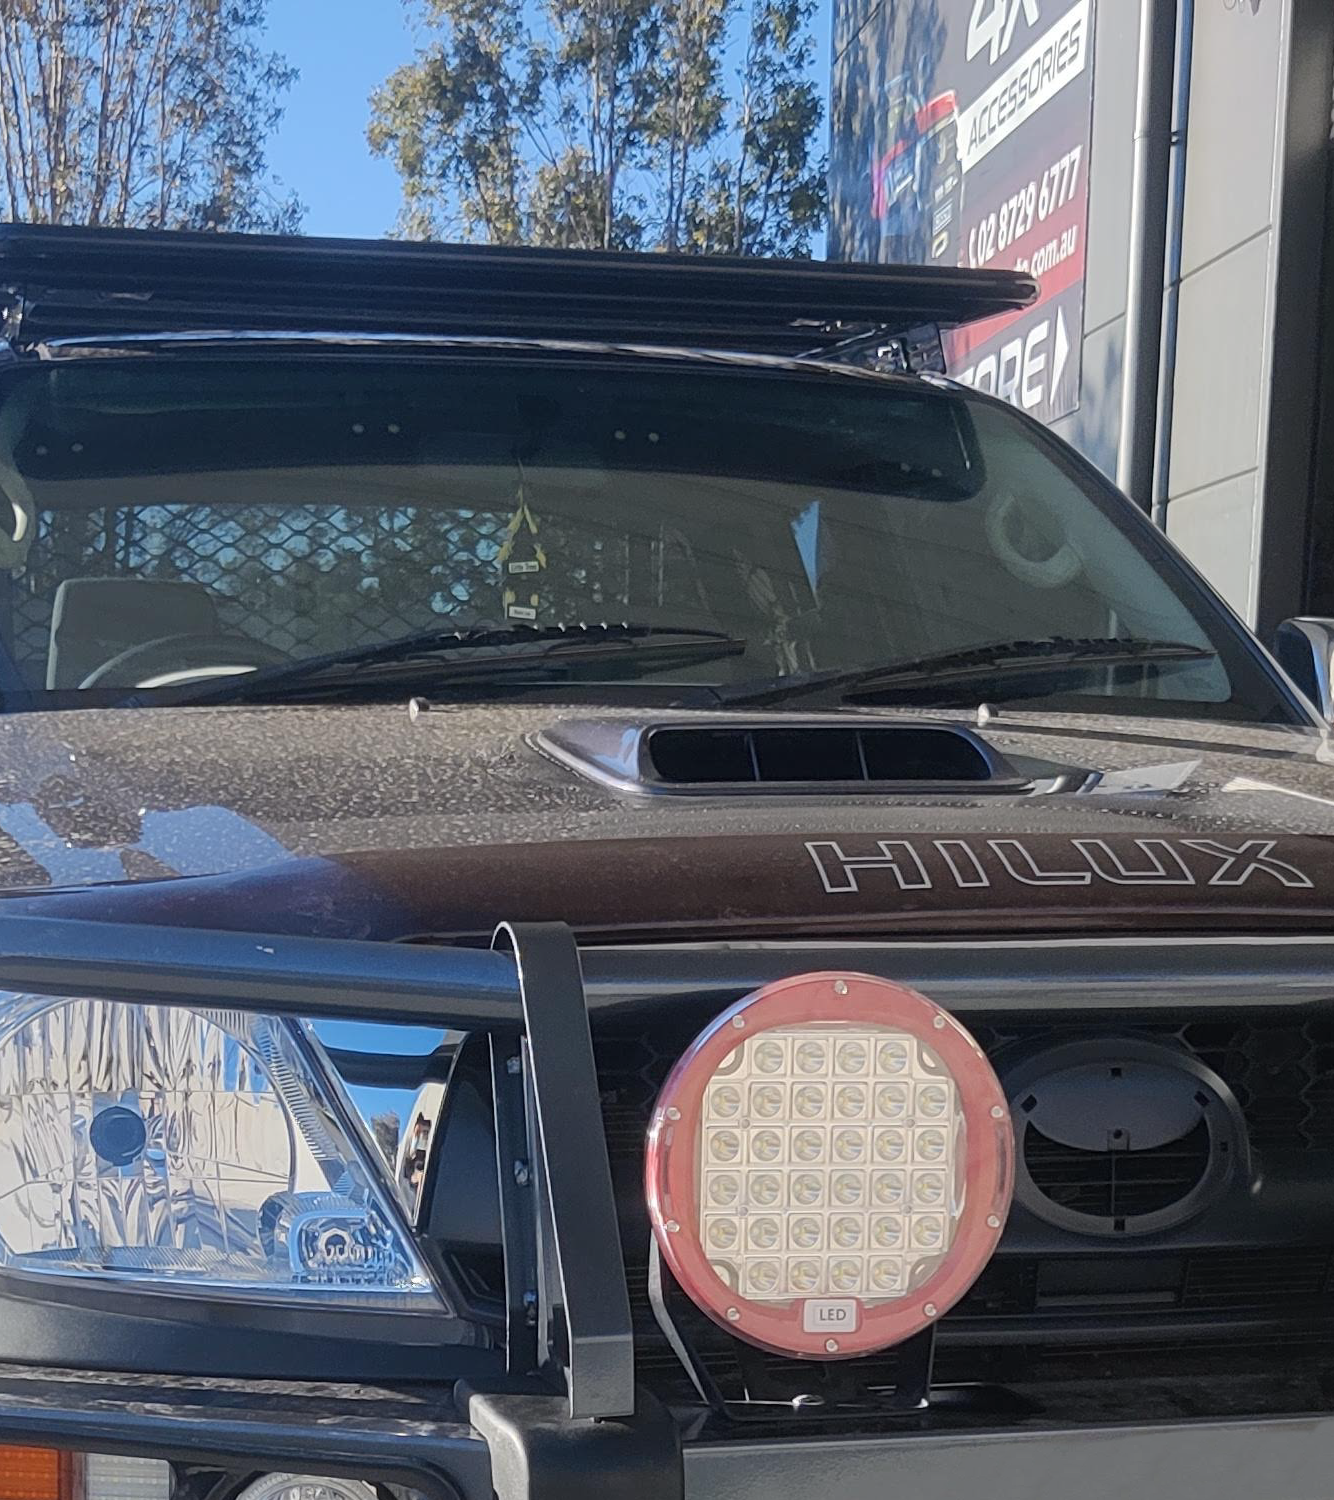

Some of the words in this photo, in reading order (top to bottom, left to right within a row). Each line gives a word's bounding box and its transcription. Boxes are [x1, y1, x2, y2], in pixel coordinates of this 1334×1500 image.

[968, 18, 1082, 156] ACCESSORIES
[977, 213, 997, 267] 02
[998, 181, 1037, 251] 8729
[1038, 144, 1083, 221] 6777
[954, 319, 1050, 409] ORE
[804, 839, 1314, 893] HILUX
[819, 1308, 847, 1321] LED
